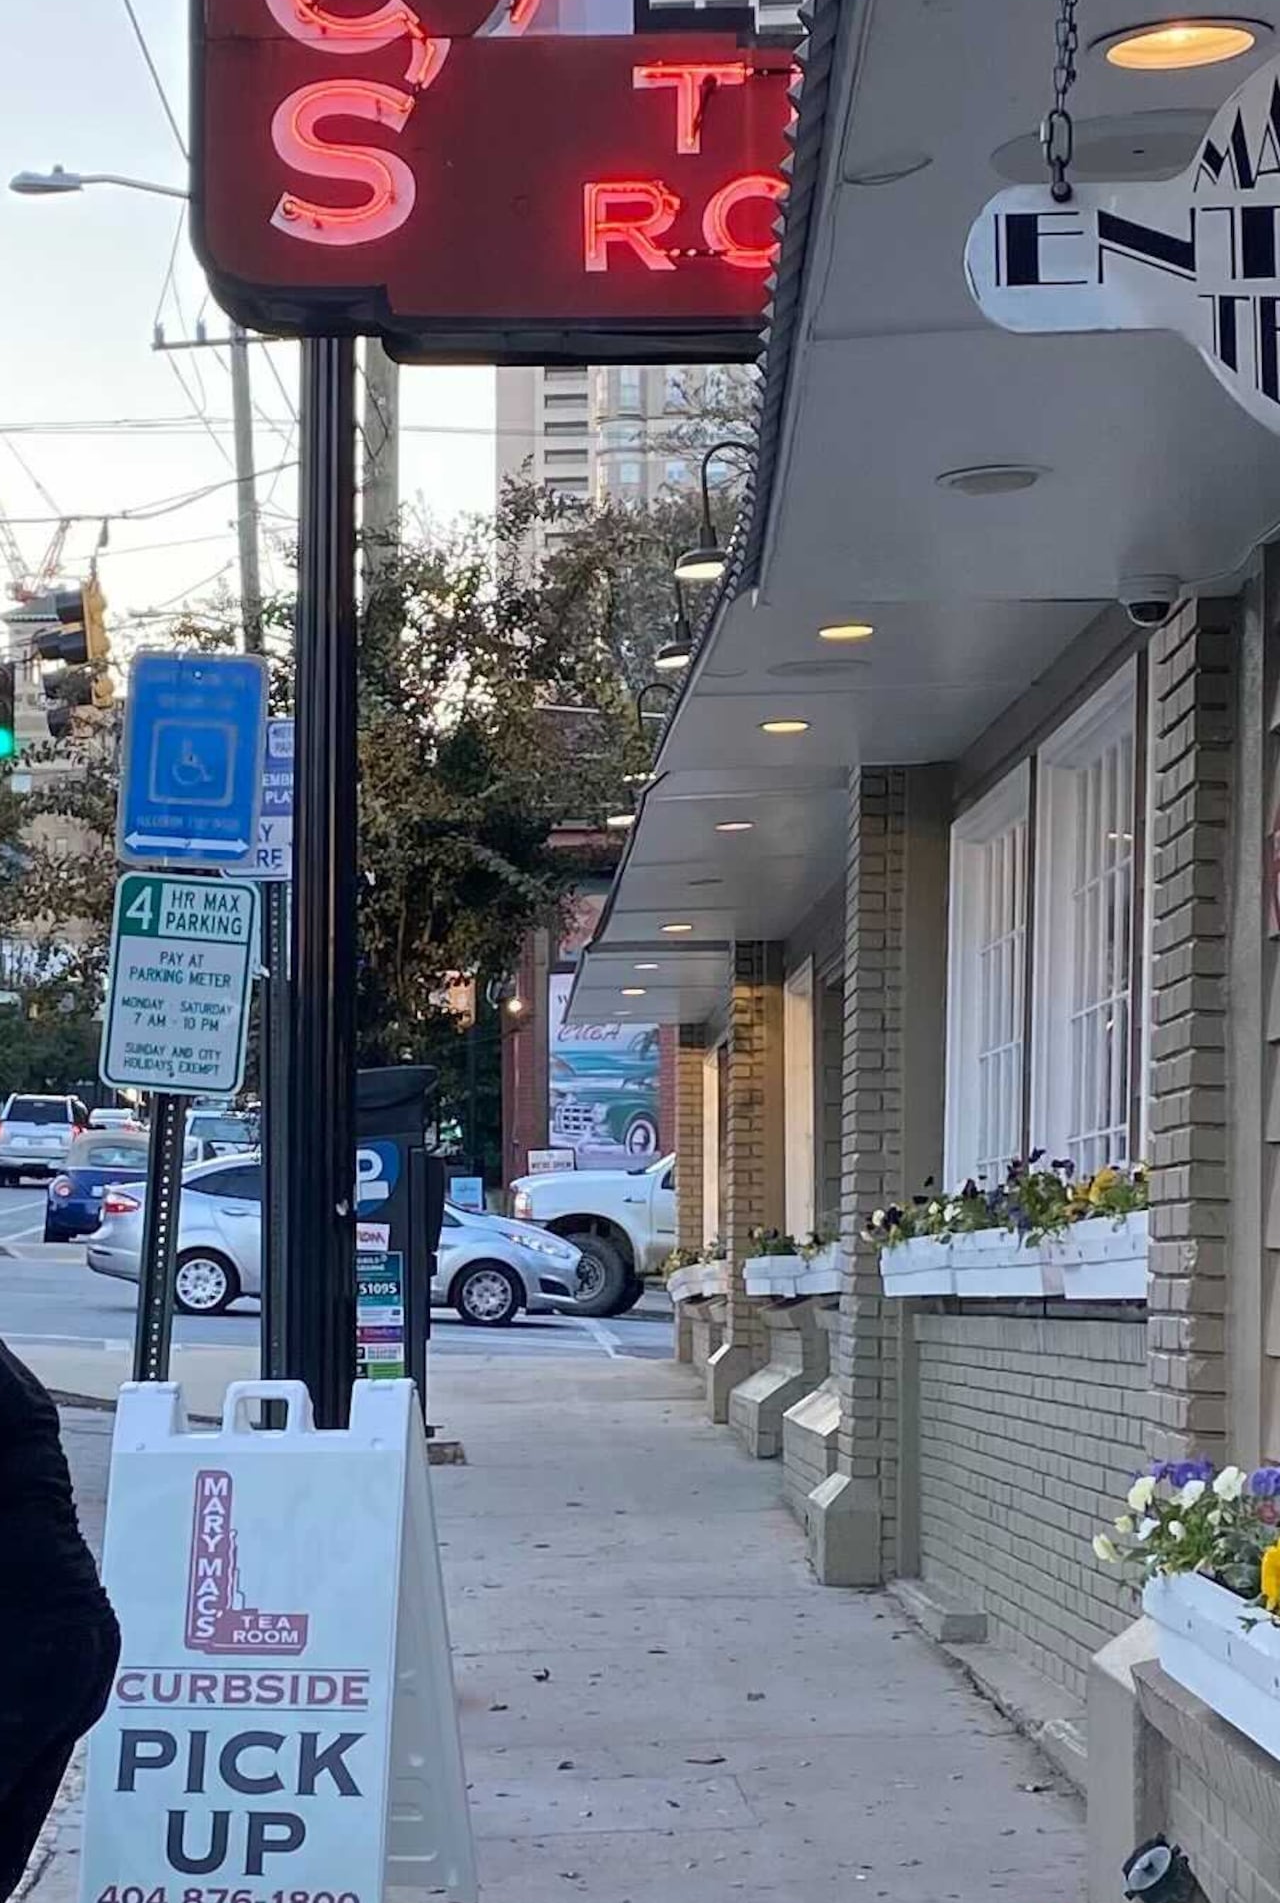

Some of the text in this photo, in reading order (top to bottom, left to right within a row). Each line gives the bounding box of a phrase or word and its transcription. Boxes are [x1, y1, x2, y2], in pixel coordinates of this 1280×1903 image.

[633, 60, 804, 154] T
[261, 773, 293, 787] EMB
[125, 885, 153, 931] 4
[170, 889, 240, 914] HR MAX
[165, 912, 242, 936] PARKING
[159, 951, 204, 968] PAY AT
[128, 967, 231, 989] PARKING METER
[121, 996, 233, 1016] MONDAY SATURDAY
[134, 1012, 141, 1026] 7
[147, 1013, 166, 1027] AM
[183, 1017, 196, 1031] 10
[200, 1018, 219, 1032] PM
[125, 1041, 221, 1061] SUNDAY AND CITY
[123, 1056, 220, 1075] HOLIDAYS EXEMPT
[195, 1477, 229, 1638] MARY MAC'S
[241, 1615, 291, 1630] TEA
[233, 1630, 298, 1644] ROOM
[115, 1673, 369, 1708] CURBSIDE
[116, 1728, 368, 1797] PICK
[165, 1809, 308, 1877] UP
